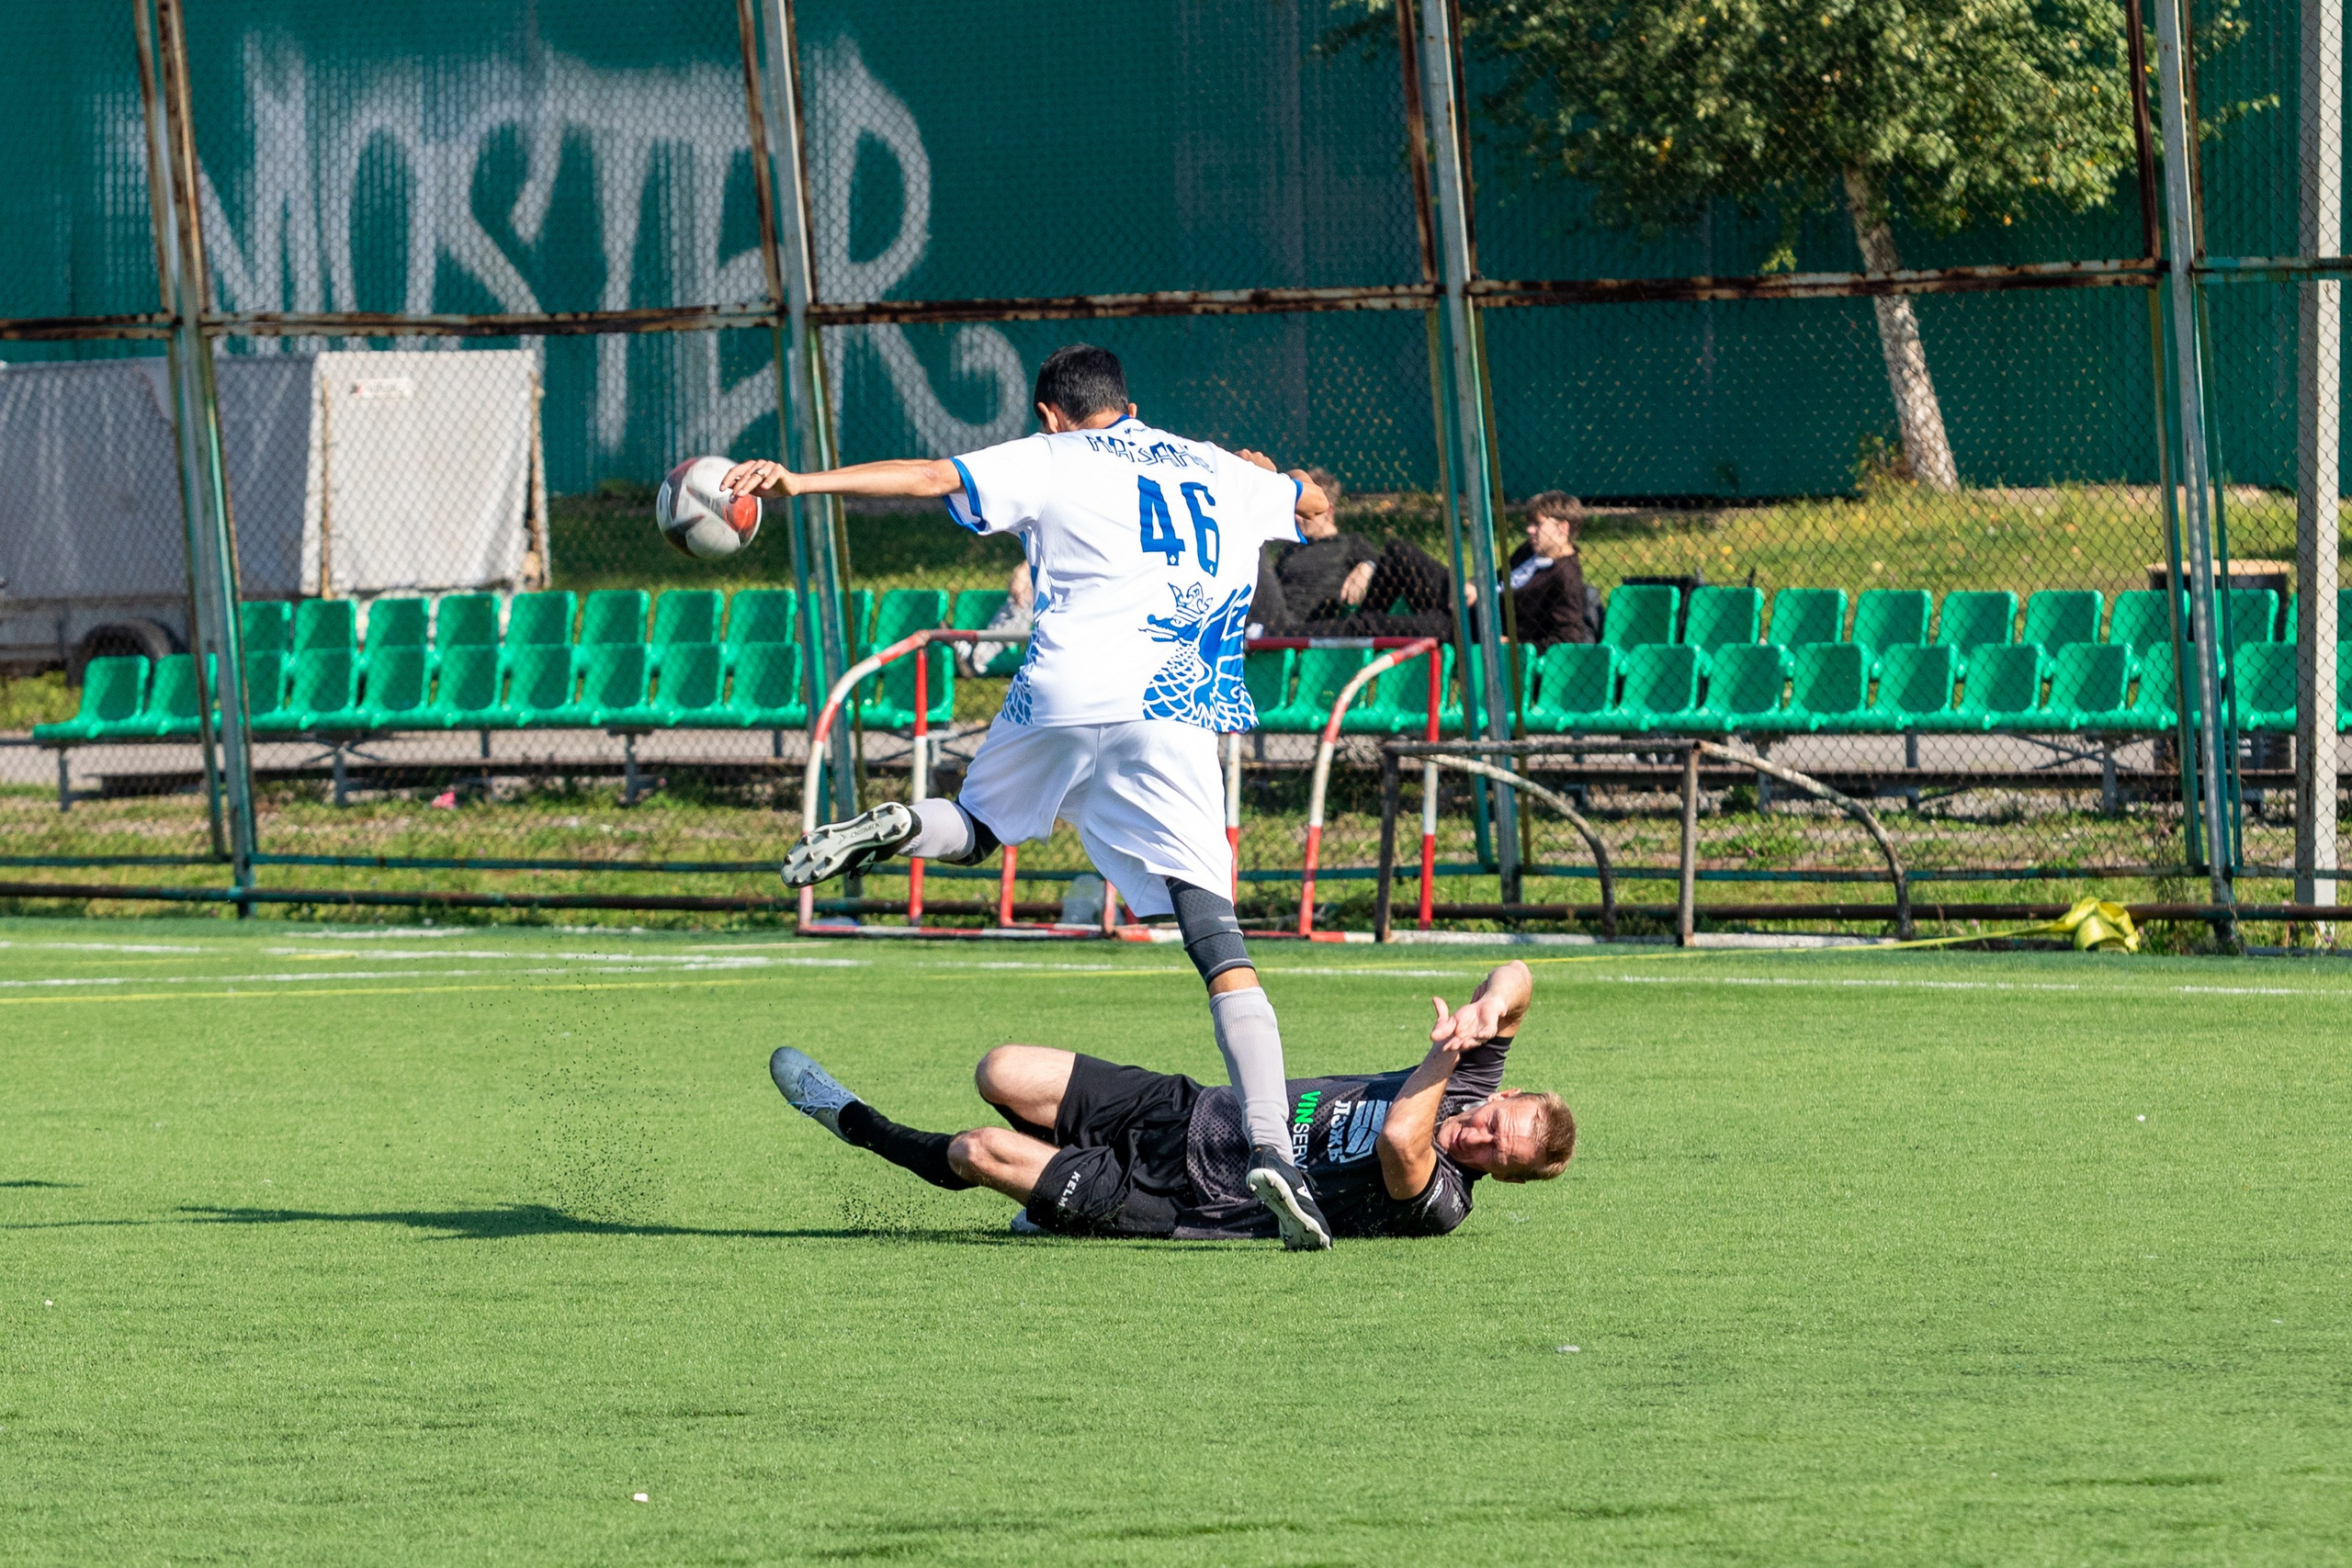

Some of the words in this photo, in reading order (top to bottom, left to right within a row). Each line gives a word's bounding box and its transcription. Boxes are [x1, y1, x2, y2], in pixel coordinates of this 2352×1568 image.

[1137, 474, 1220, 578] 46
[1292, 1089, 1322, 1173] VINSERV
[1057, 1170, 1081, 1211] KELM
